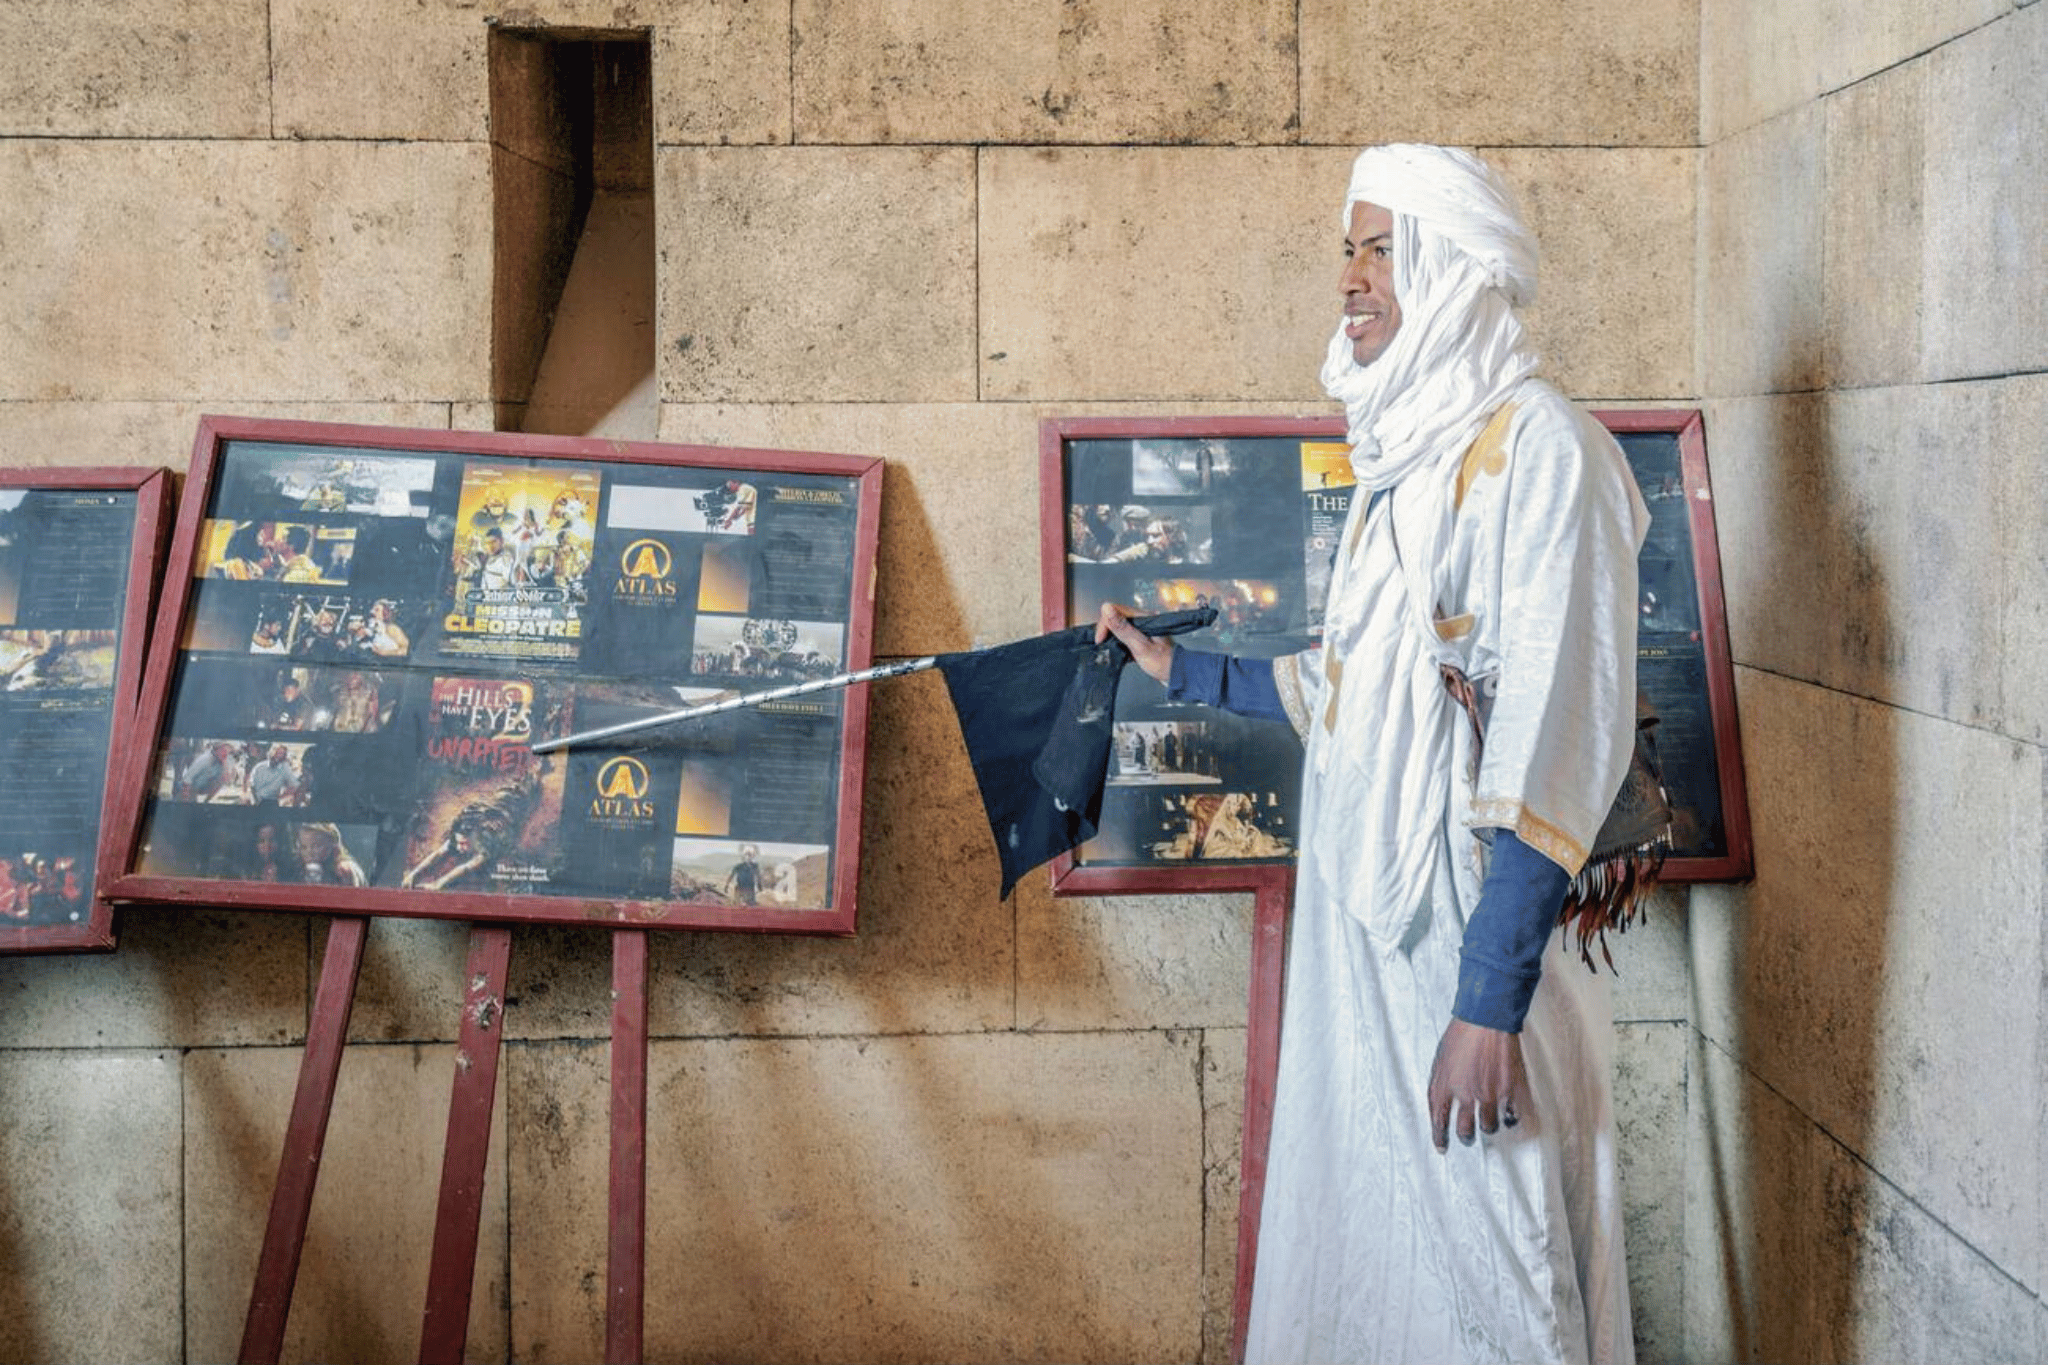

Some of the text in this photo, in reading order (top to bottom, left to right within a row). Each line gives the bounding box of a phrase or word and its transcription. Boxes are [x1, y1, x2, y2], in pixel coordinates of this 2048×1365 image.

[1307, 492, 1348, 511] THE
[613, 578, 676, 595] ATLAS
[444, 613, 581, 637] CLEOPATRE
[456, 686, 513, 707] HILLS
[469, 705, 532, 732] EYES
[589, 798, 653, 817] ATLAS
